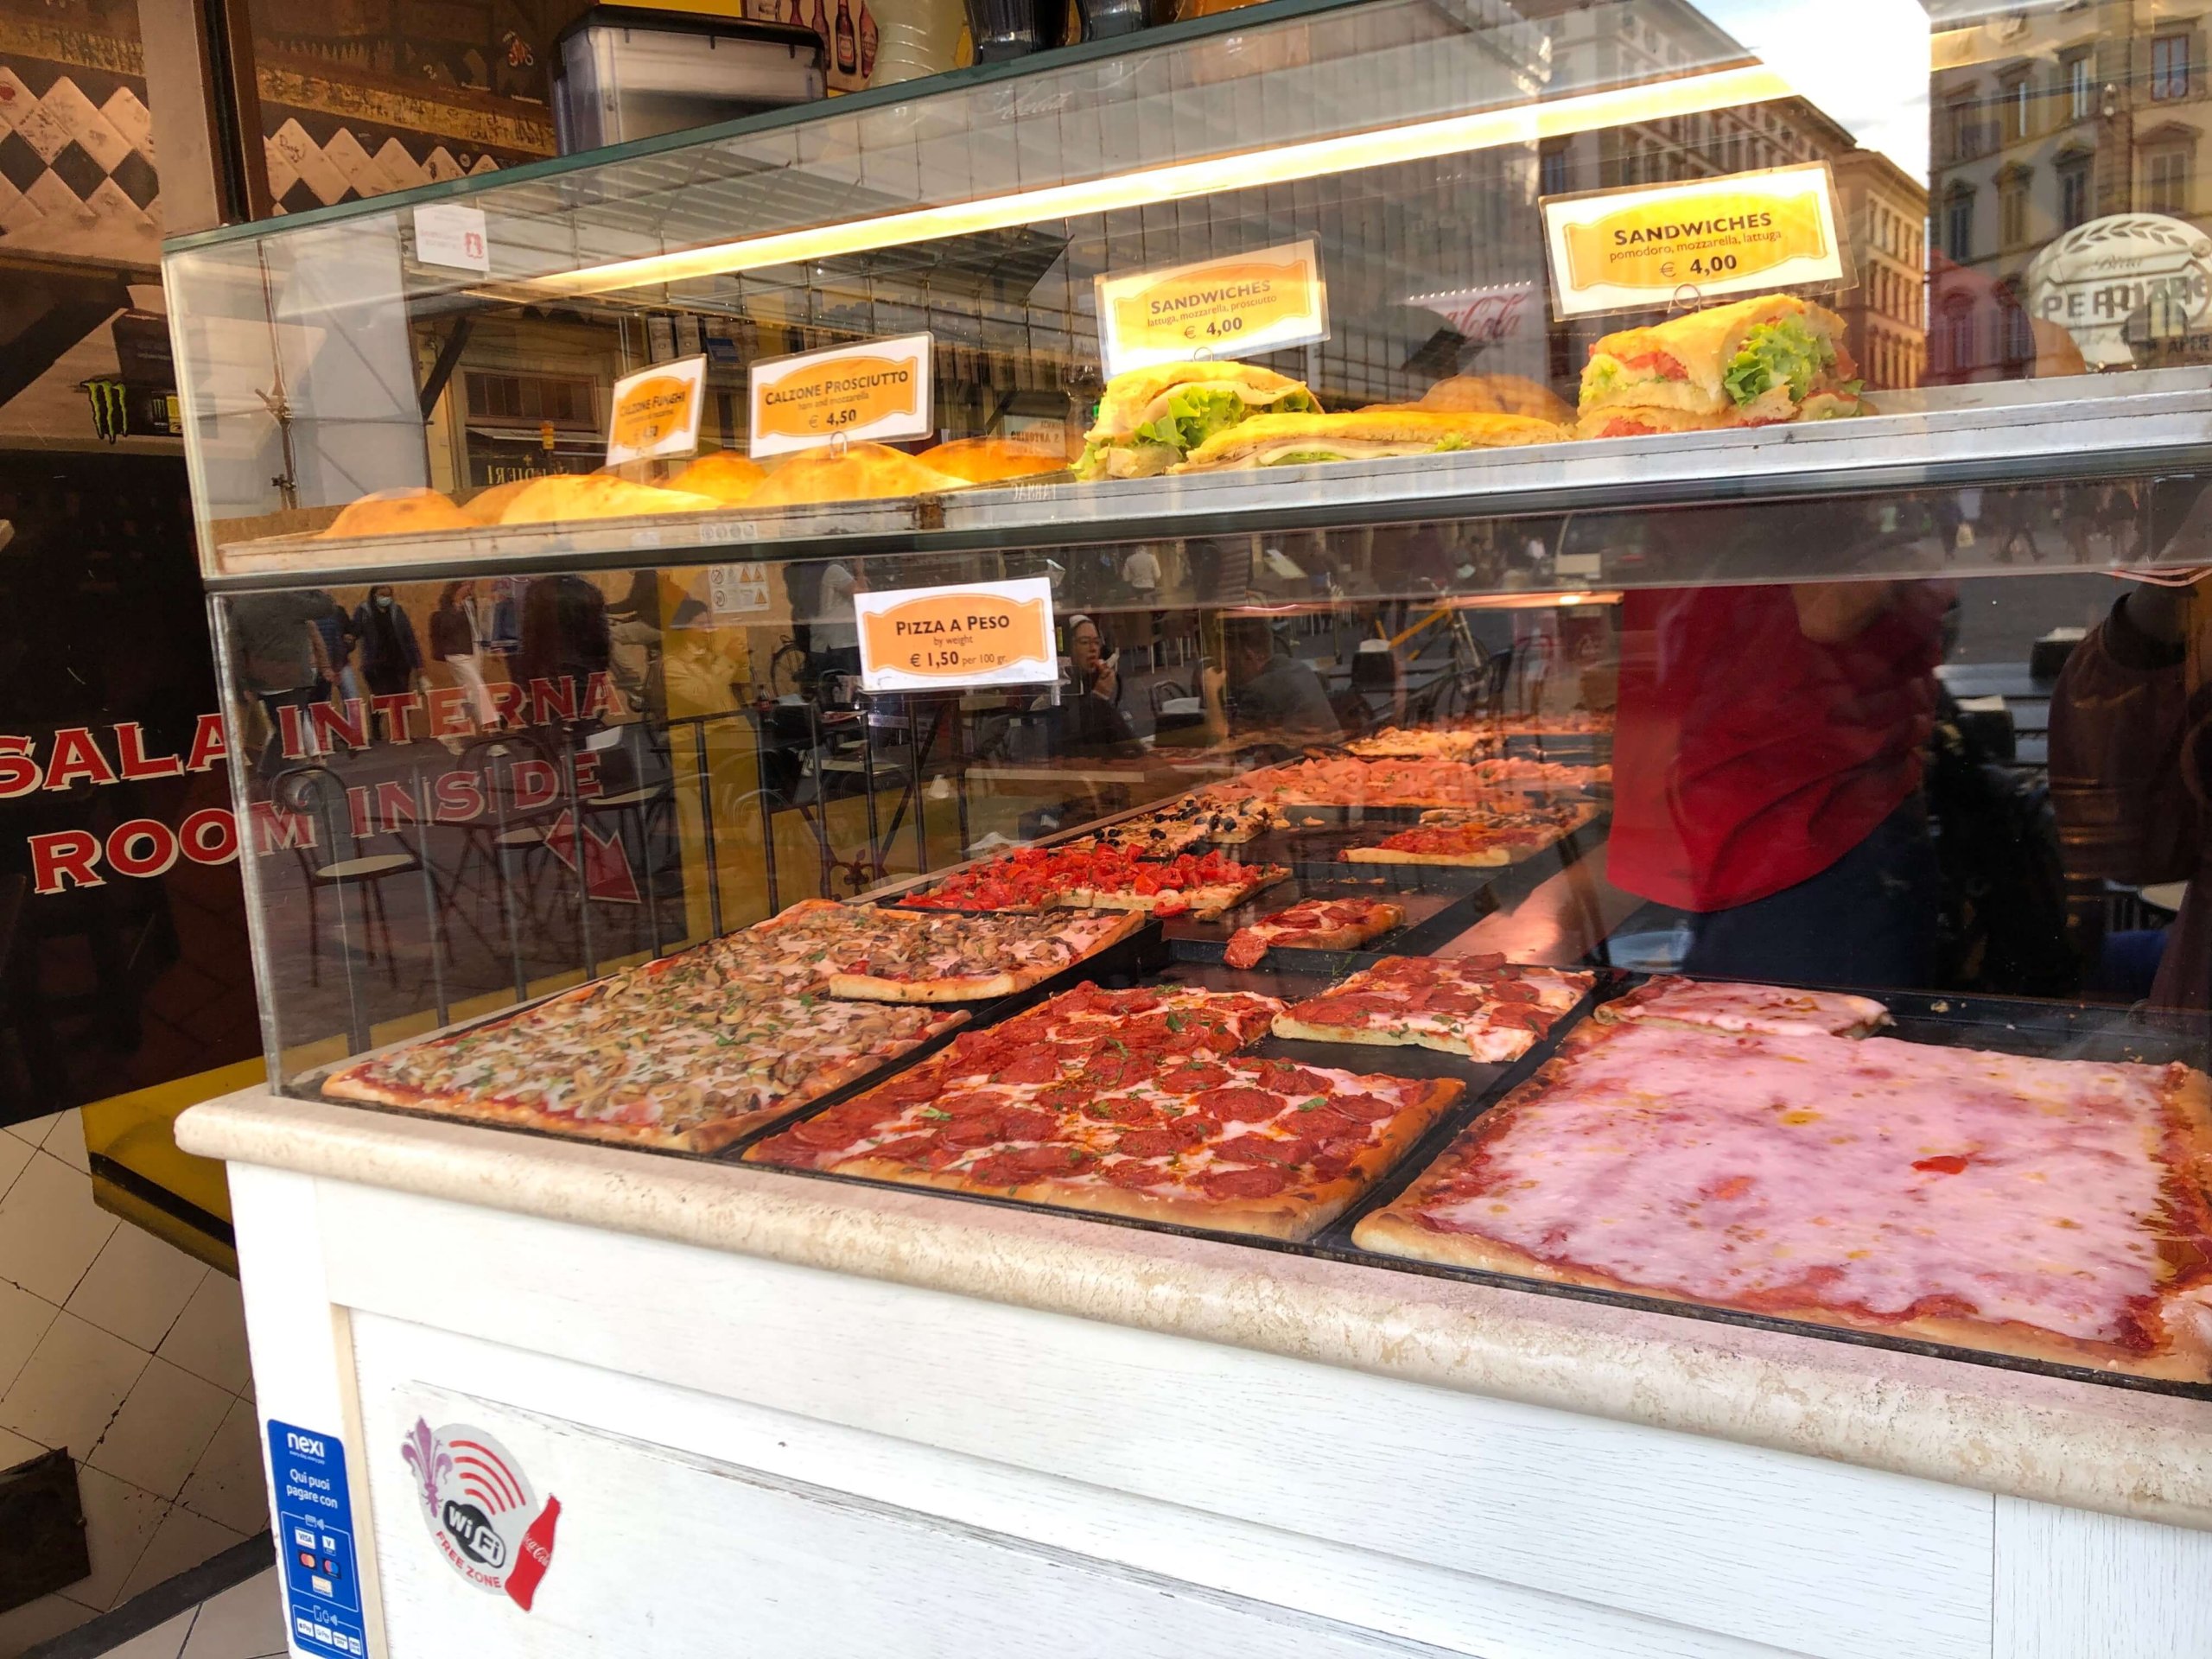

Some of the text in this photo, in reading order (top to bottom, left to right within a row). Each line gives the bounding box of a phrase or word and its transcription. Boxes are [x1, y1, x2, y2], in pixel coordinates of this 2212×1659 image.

[1614, 213, 1771, 246] SANDWICHES
[1610, 230, 1782, 263] pomodoro, mozzarella, lattuga
[1660, 254, 1738, 277] € 4,00
[1151, 279, 1271, 315] SANDWICHES
[1147, 295, 1277, 327] lattuga, mozzarella, prosciutto
[1184, 316, 1243, 339] € 4,00
[766, 371, 908, 405] CALZONE PROSCIUTTO
[809, 409, 856, 429] € 4,50
[896, 614, 1010, 636] PIZZA A PESO
[933, 635, 974, 648] by weight
[910, 653, 921, 667] €
[927, 651, 959, 669] 1,50
[962, 657, 976, 667] per
[980, 654, 995, 664] 100
[0, 671, 626, 799] SALA INTERNA
[28, 750, 603, 895] ROOM INSIDE
[287, 1432, 325, 1458] nexi
[289, 1468, 330, 1491] Qui puoi
[286, 1484, 339, 1510] pagare con
[436, 1530, 502, 1588] FREE ZONE
